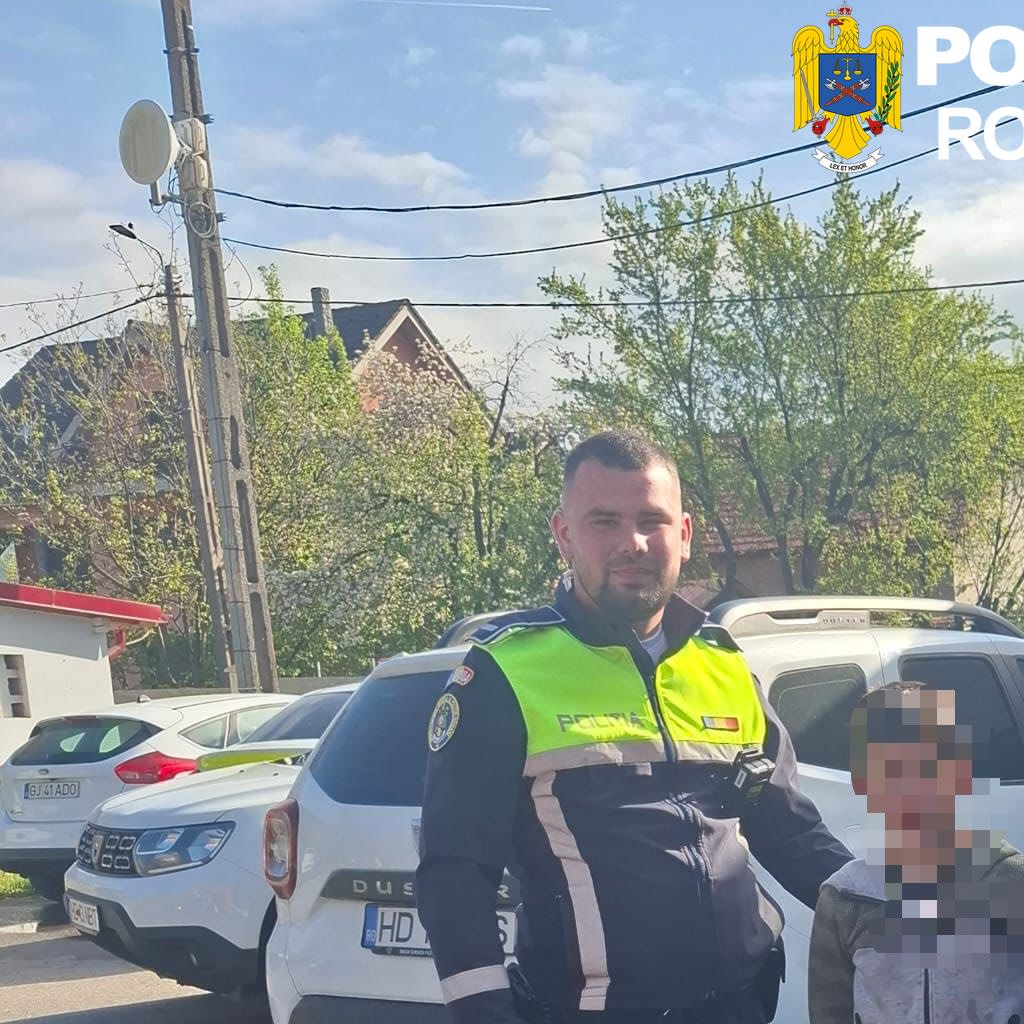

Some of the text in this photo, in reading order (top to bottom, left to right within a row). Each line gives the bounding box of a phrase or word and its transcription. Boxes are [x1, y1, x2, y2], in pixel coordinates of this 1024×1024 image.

[29, 785, 40, 796] GJ
[43, 784, 53, 796] 41
[379, 911, 413, 942] HD
